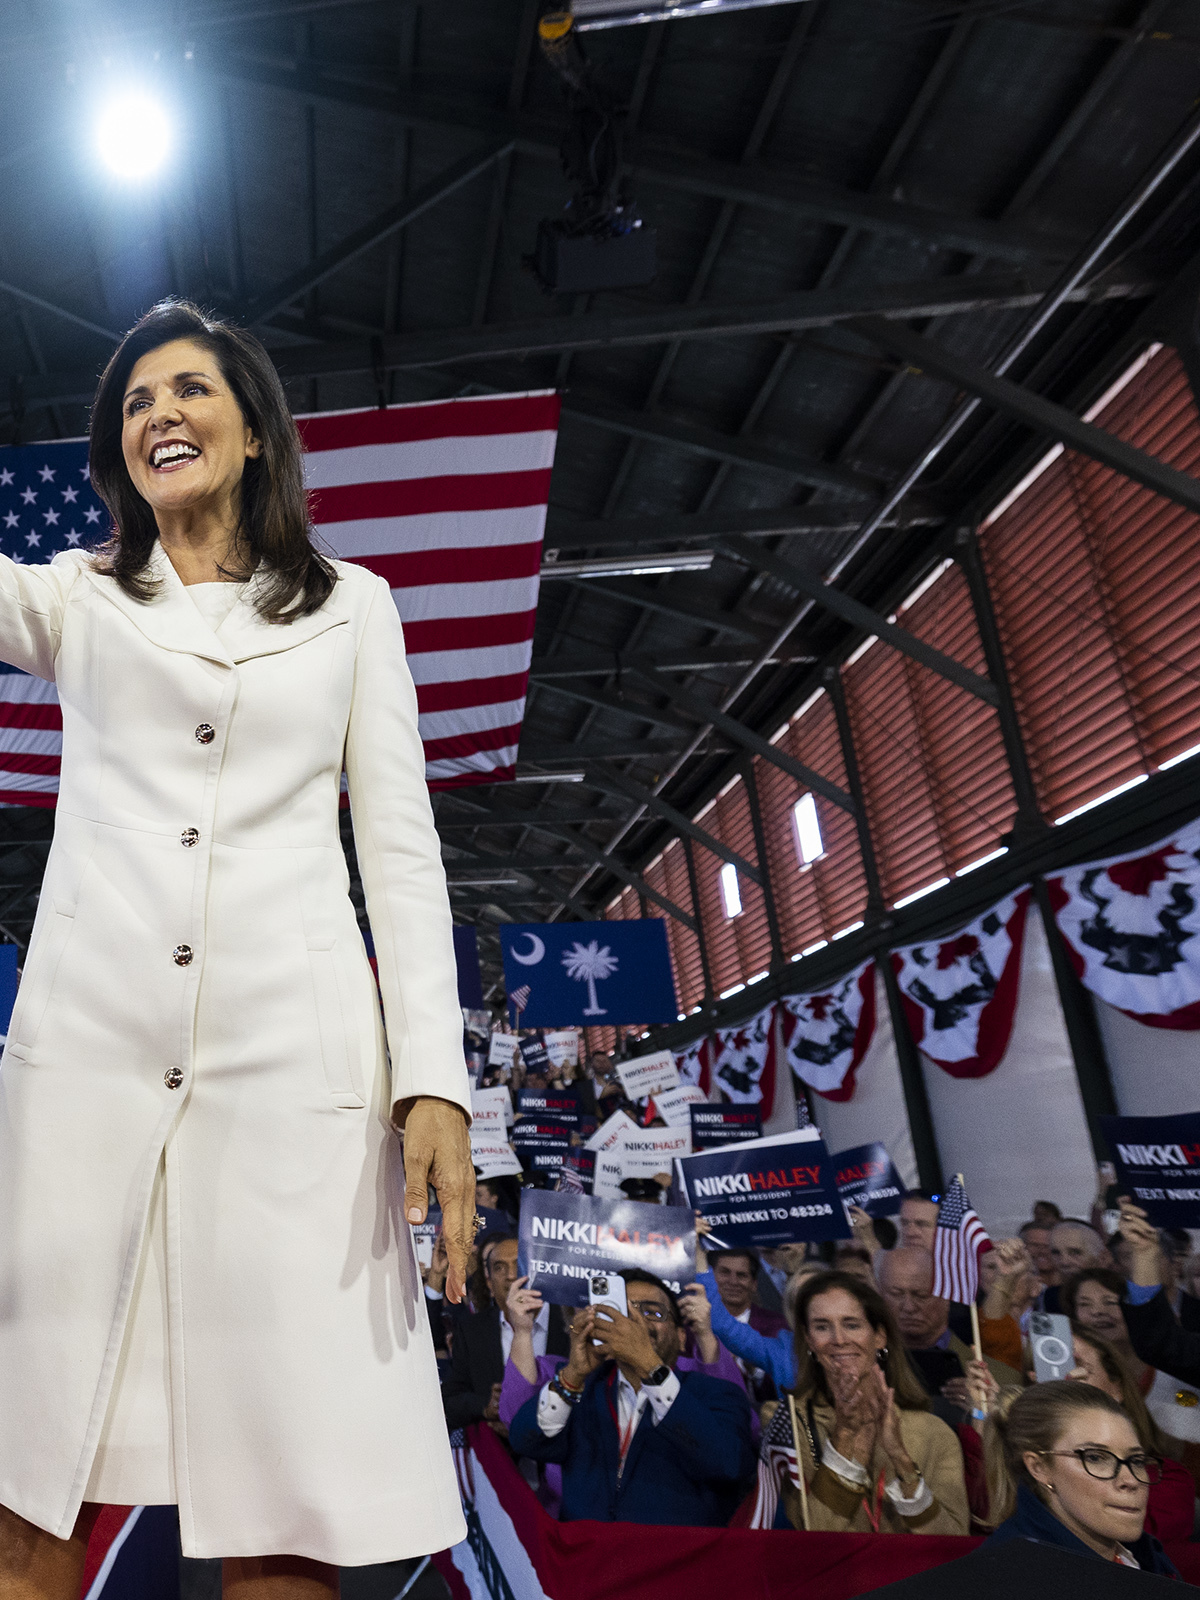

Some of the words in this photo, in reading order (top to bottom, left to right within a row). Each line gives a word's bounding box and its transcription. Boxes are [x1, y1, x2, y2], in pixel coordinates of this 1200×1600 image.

[521, 1097, 576, 1109] NIKKIHALEY
[694, 1113, 757, 1123] NIKKIHALEY
[514, 1124, 568, 1135] NIKKIHALEY
[625, 1139, 687, 1151] NIKKIHALEY
[694, 1165, 821, 1197] NIKKIHALEY
[749, 1190, 792, 1202] PRESIDENT
[730, 1211, 769, 1224] NIKKI
[771, 1207, 789, 1220] TO
[790, 1203, 833, 1218] 48324
[567, 1245, 586, 1256] FOR
[530, 1259, 560, 1275] TEXT
